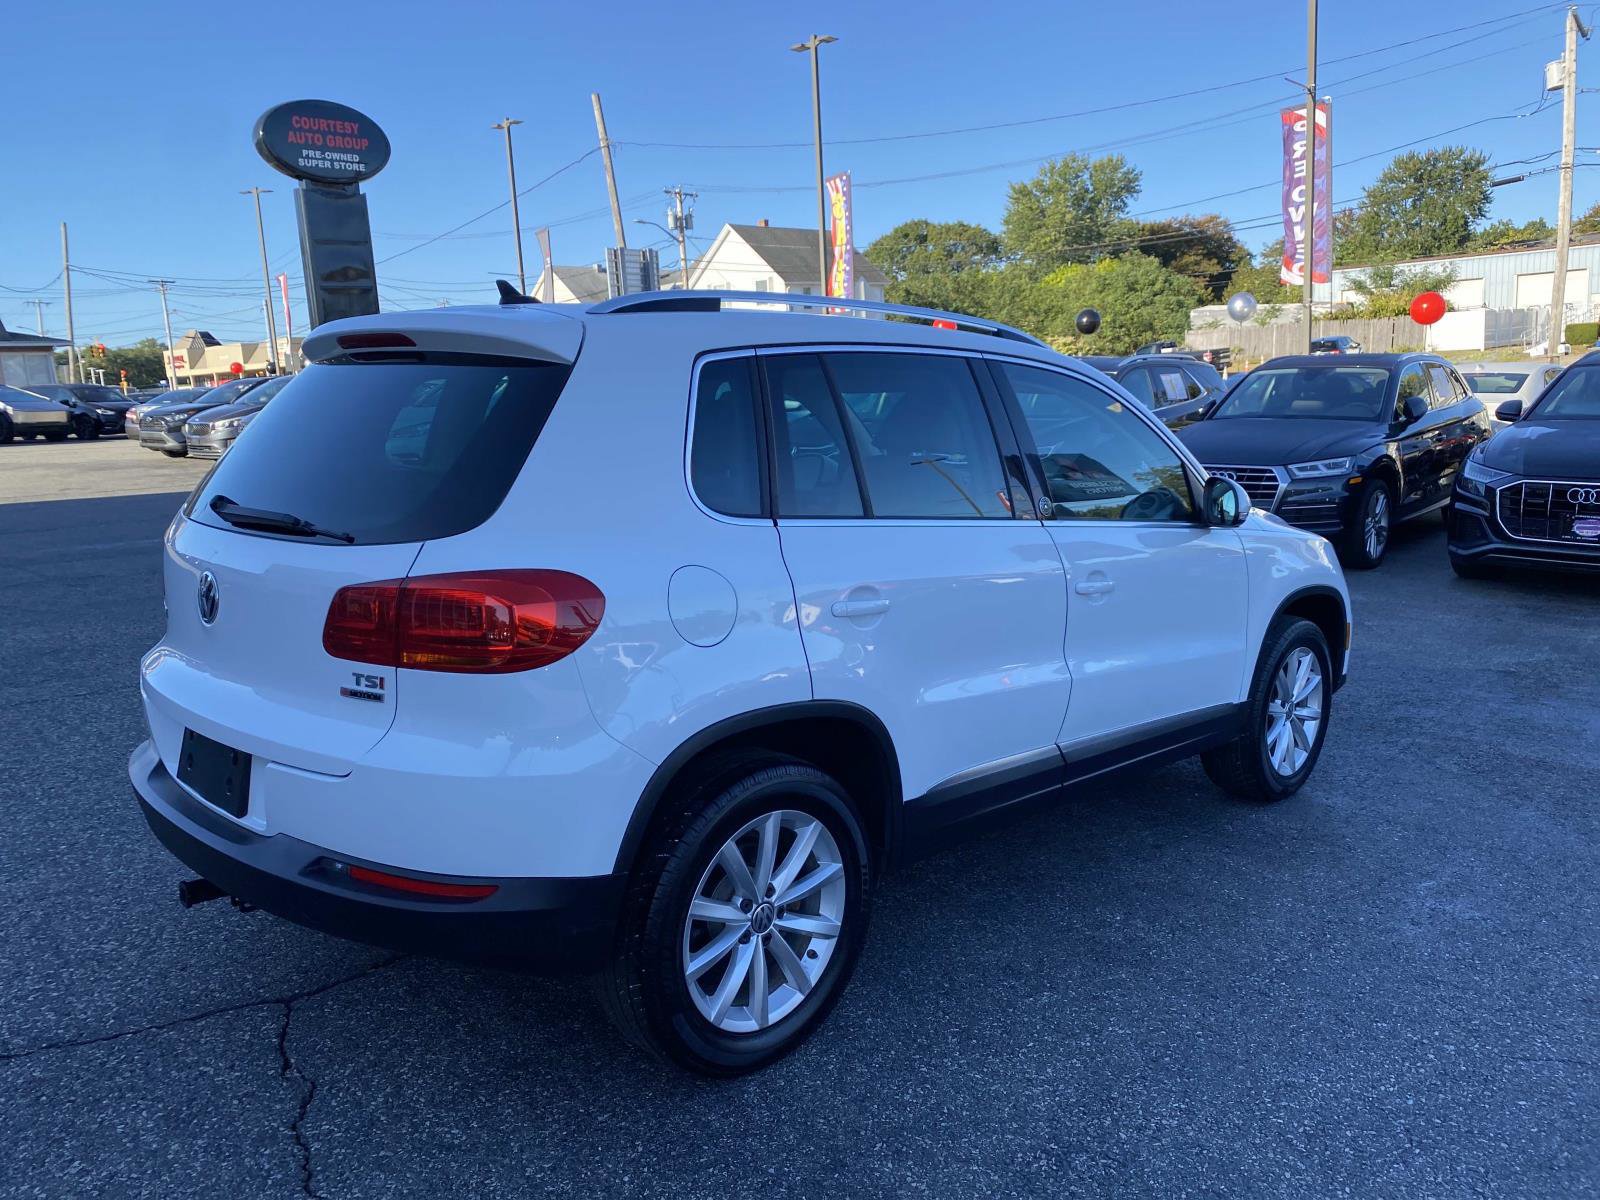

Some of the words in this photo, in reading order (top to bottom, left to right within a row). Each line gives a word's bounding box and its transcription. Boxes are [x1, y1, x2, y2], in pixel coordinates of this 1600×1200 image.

[292, 115, 359, 134] COURTESY
[288, 131, 323, 146] AUTO
[326, 135, 369, 151] GROUP
[302, 149, 360, 162] PRE-OWNED
[298, 158, 332, 169] SUPER
[333, 161, 366, 172] STORE
[352, 672, 384, 690] TSI
